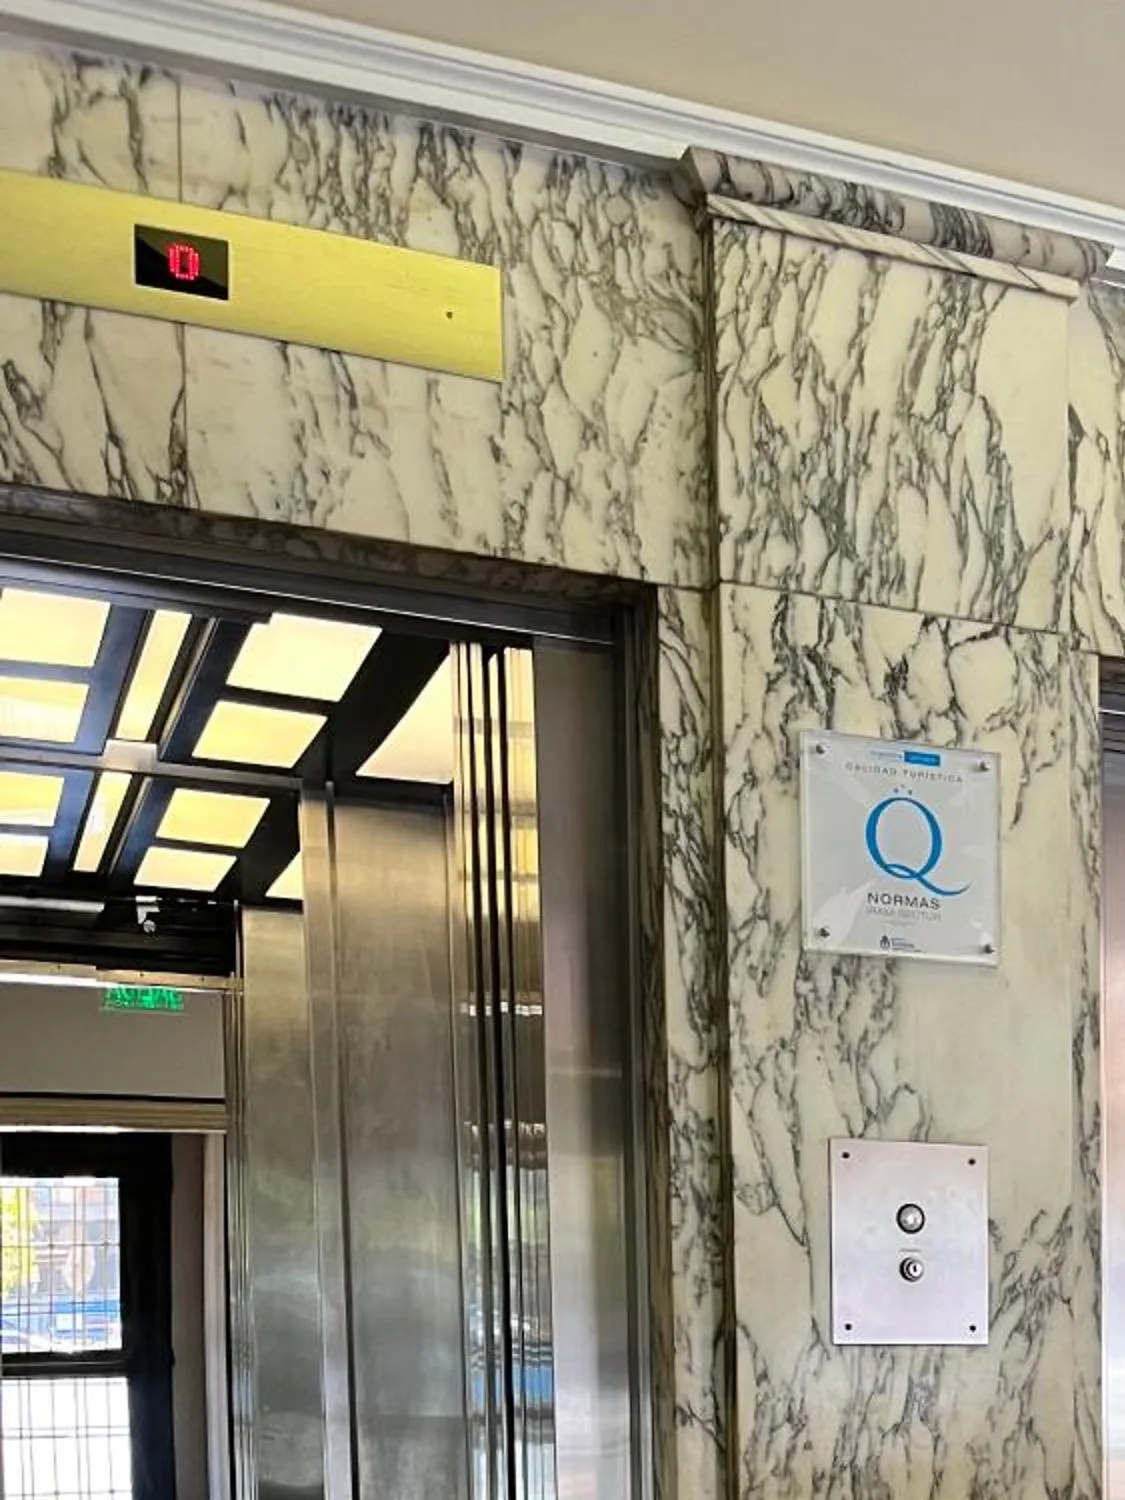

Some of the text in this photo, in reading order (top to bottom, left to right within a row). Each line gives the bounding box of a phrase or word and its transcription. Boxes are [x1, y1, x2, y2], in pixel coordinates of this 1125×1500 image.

[168, 244, 199, 281] 0
[865, 797, 971, 896] Q
[866, 891, 941, 911] NORMAS
